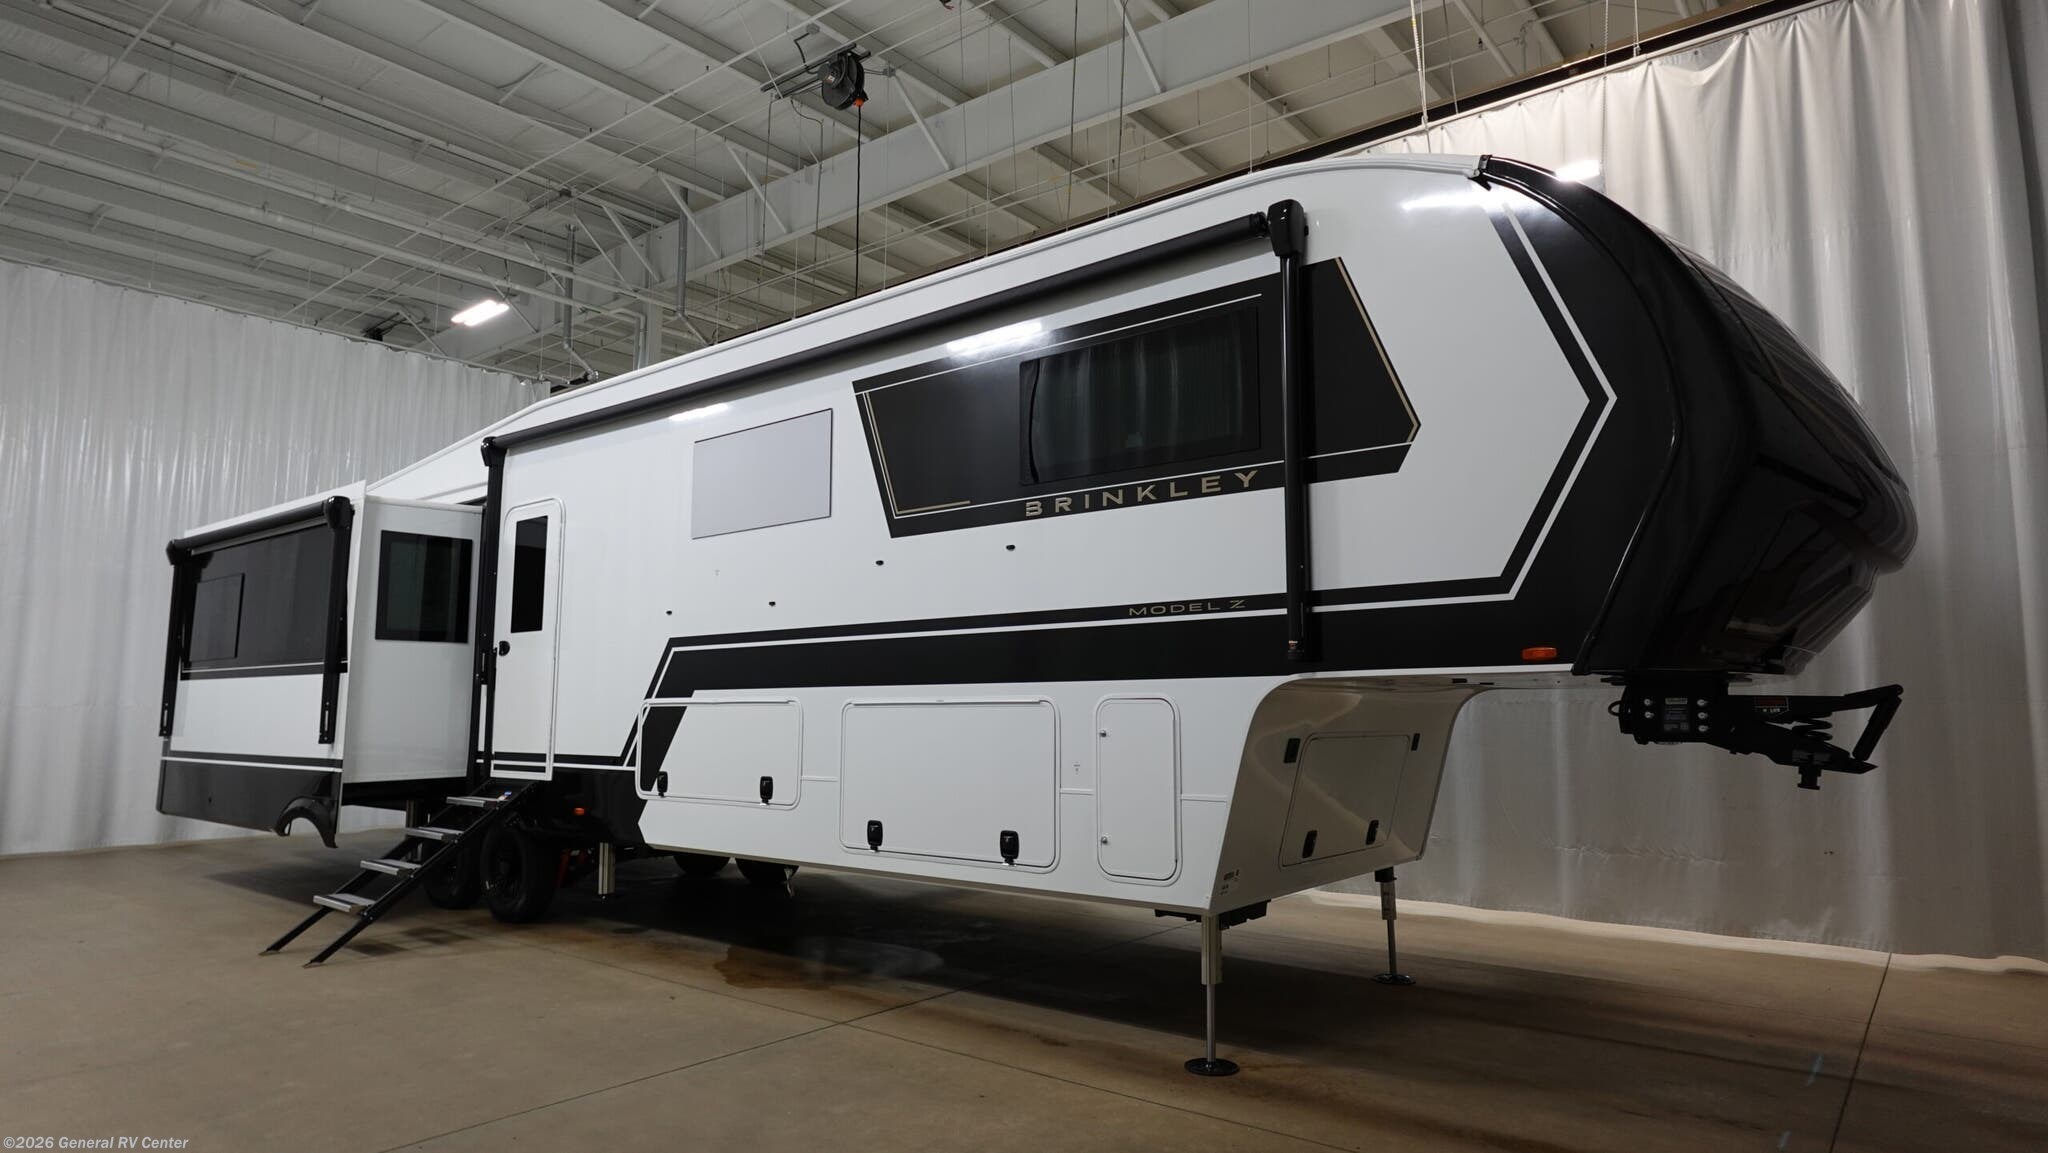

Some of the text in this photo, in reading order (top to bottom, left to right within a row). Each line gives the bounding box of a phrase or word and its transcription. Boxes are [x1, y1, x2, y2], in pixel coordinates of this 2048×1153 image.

[1025, 470, 1258, 517] BRINKLEY
[1129, 600, 1246, 616] MODEL Z
